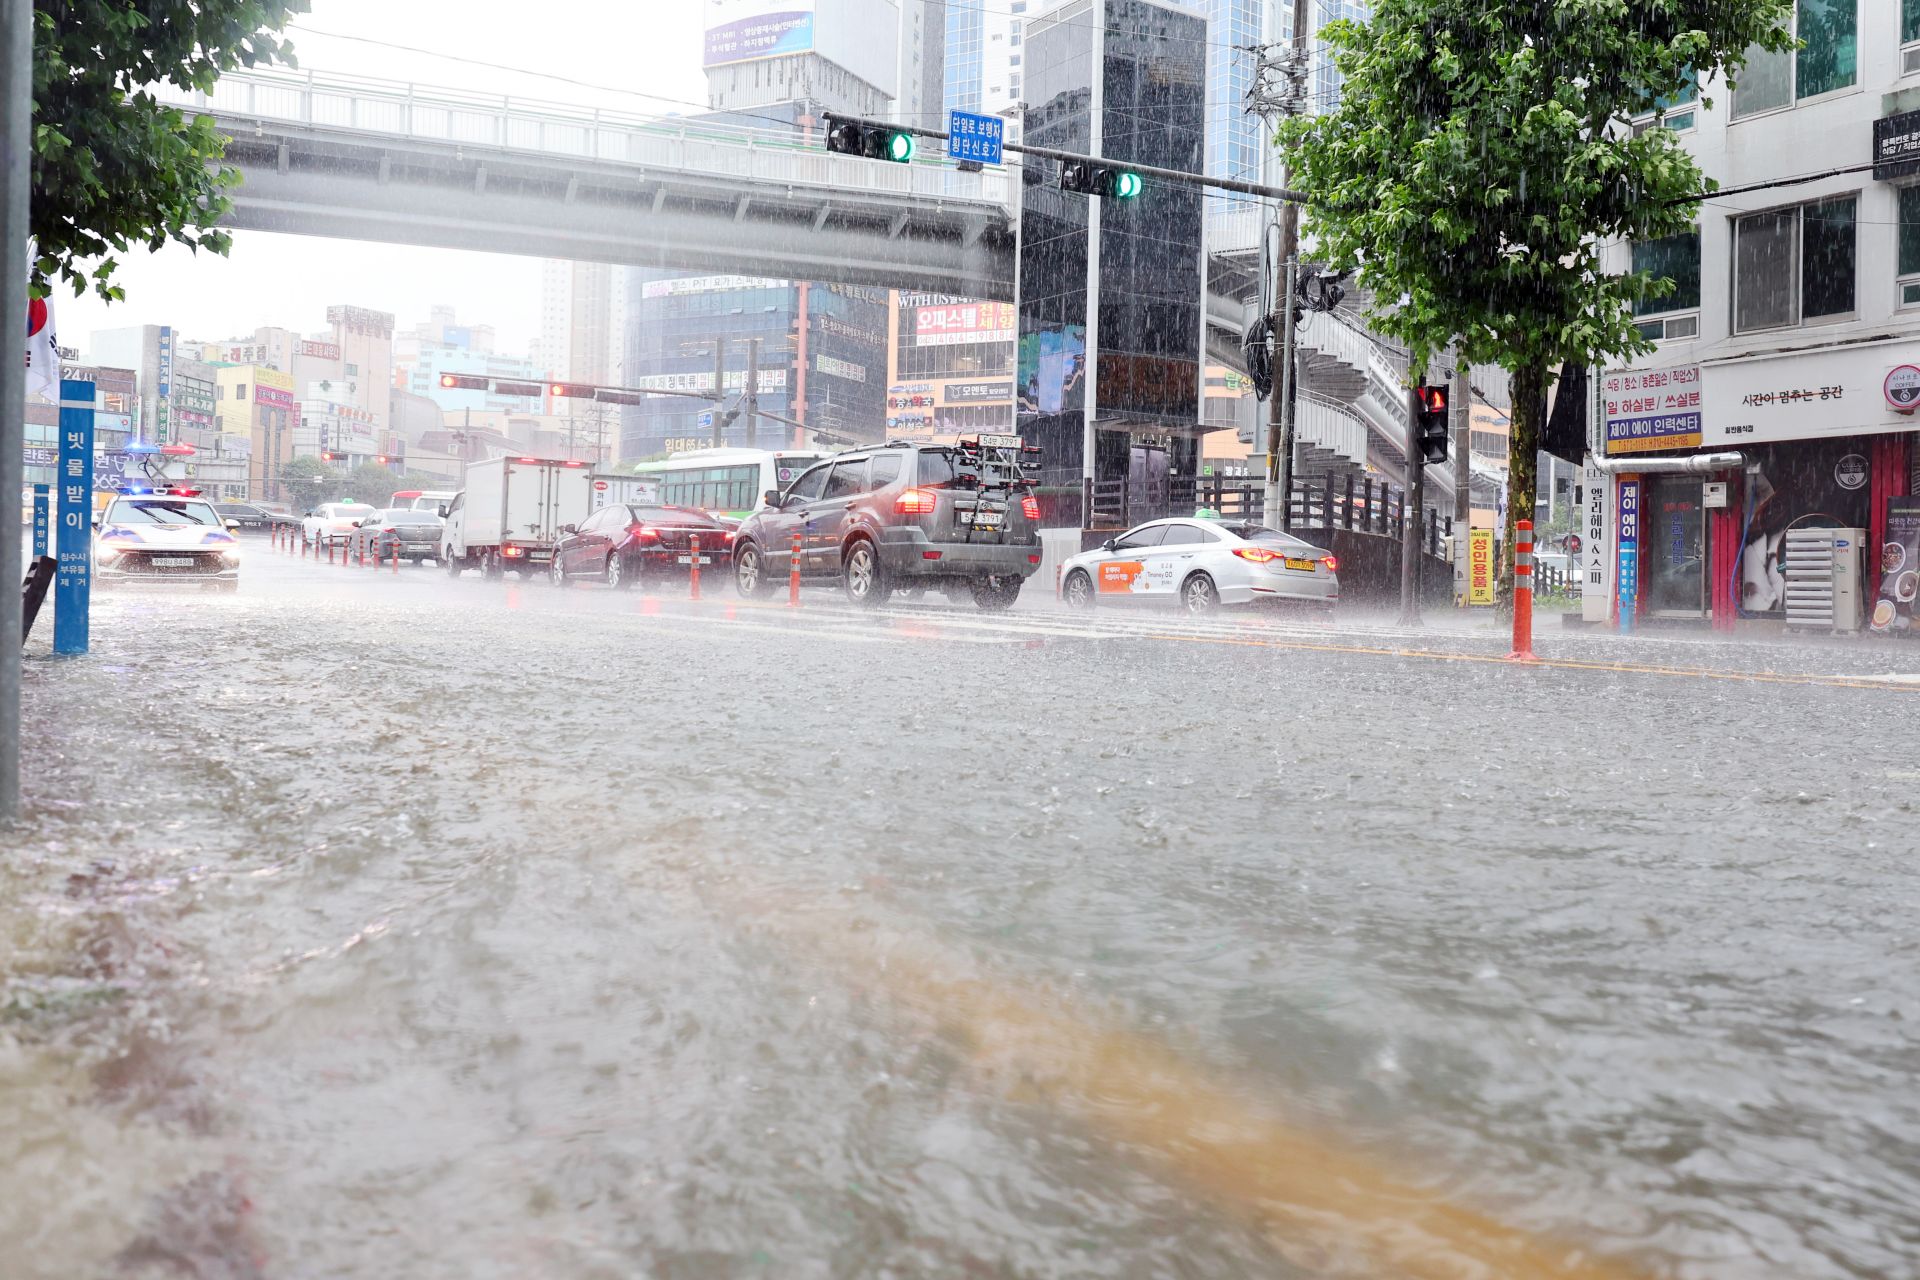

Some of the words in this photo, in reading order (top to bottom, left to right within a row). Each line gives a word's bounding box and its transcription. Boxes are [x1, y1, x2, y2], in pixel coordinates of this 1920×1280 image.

[952, 116, 975, 134] 단일로
[978, 121, 1000, 139] 보행자
[952, 136, 1000, 160] 횡단신호기
[1882, 134, 1910, 148] 등록번호
[1882, 146, 1896, 155] 식당
[693, 279, 708, 288] PT
[714, 277, 730, 286] 요가
[898, 294, 932, 308] WITH
[934, 294, 949, 305] US
[918, 308, 976, 329] 오피스텔
[1608, 378, 1620, 392] 식당
[1624, 376, 1637, 390] 청소
[1642, 372, 1668, 388] 농촌일손
[1673, 368, 1700, 384] 직업소개
[1608, 402, 1618, 415] 일
[1665, 392, 1700, 408] 쓰실분
[1742, 392, 1774, 406] 시간이
[1779, 388, 1814, 404] 멈추는
[1820, 385, 1843, 400] 공간
[1610, 422, 1629, 438] 제이
[1632, 420, 1652, 435] 에이
[1725, 424, 1754, 434] 일반음식점
[664, 438, 684, 452] 임대
[1000, 438, 1018, 447] 3791
[66, 432, 85, 530] 빗물받이
[1622, 486, 1636, 510] 제이
[982, 514, 999, 522] 3791
[1590, 488, 1602, 540] 엘리헤어
[37, 506, 46, 550] 빗물받이
[1622, 514, 1636, 537] 에이
[1592, 544, 1600, 554] &
[1672, 514, 1683, 564] 인력센터
[61, 552, 86, 562] 침수시
[1473, 538, 1488, 588] 성인용품
[60, 565, 86, 574] 부유물
[1590, 560, 1602, 584] 스파
